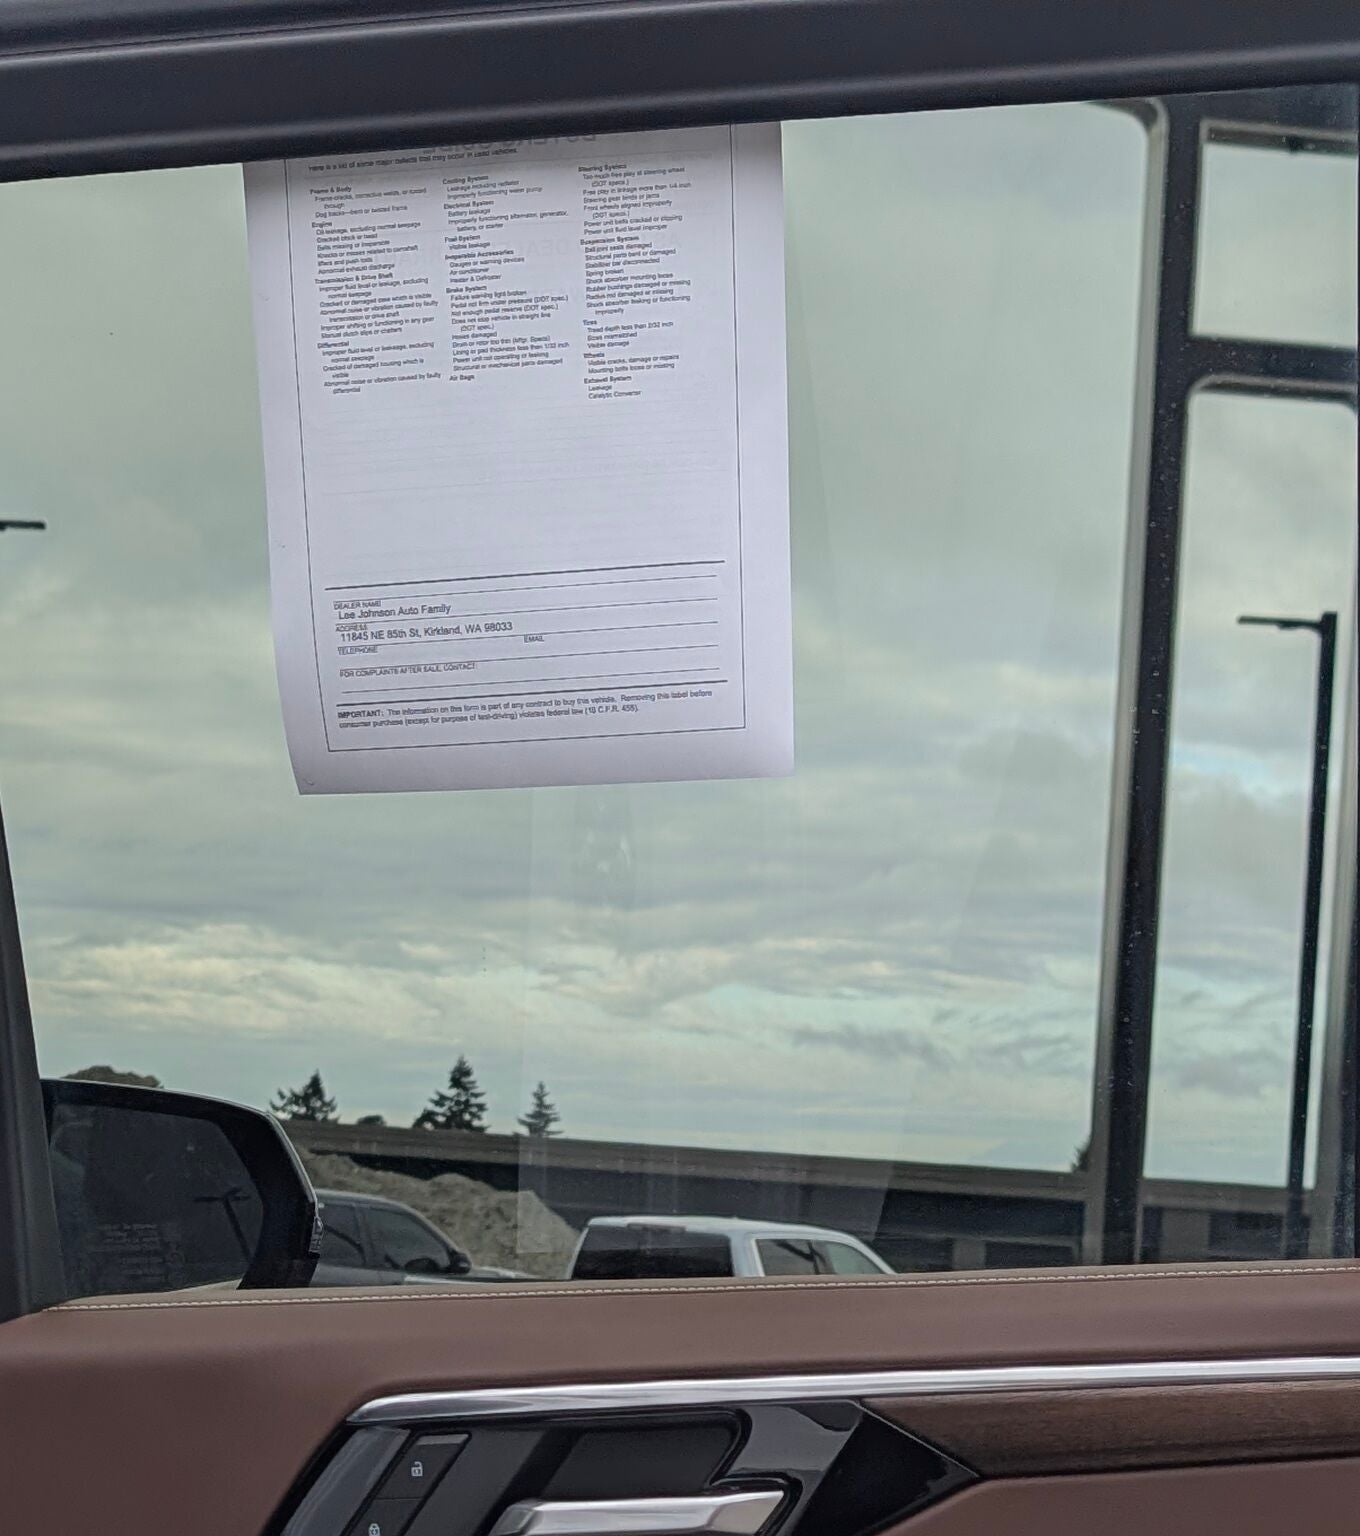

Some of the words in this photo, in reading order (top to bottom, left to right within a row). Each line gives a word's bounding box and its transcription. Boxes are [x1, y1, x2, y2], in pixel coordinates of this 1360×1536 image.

[337, 610, 356, 619] Lee
[357, 608, 396, 618] Johnson
[397, 605, 419, 615] Auto
[420, 603, 451, 616] Family
[341, 631, 368, 642] 11845
[370, 629, 384, 640] NE
[386, 628, 407, 638] 85th
[464, 623, 481, 633] WA
[483, 621, 512, 632] 98033
